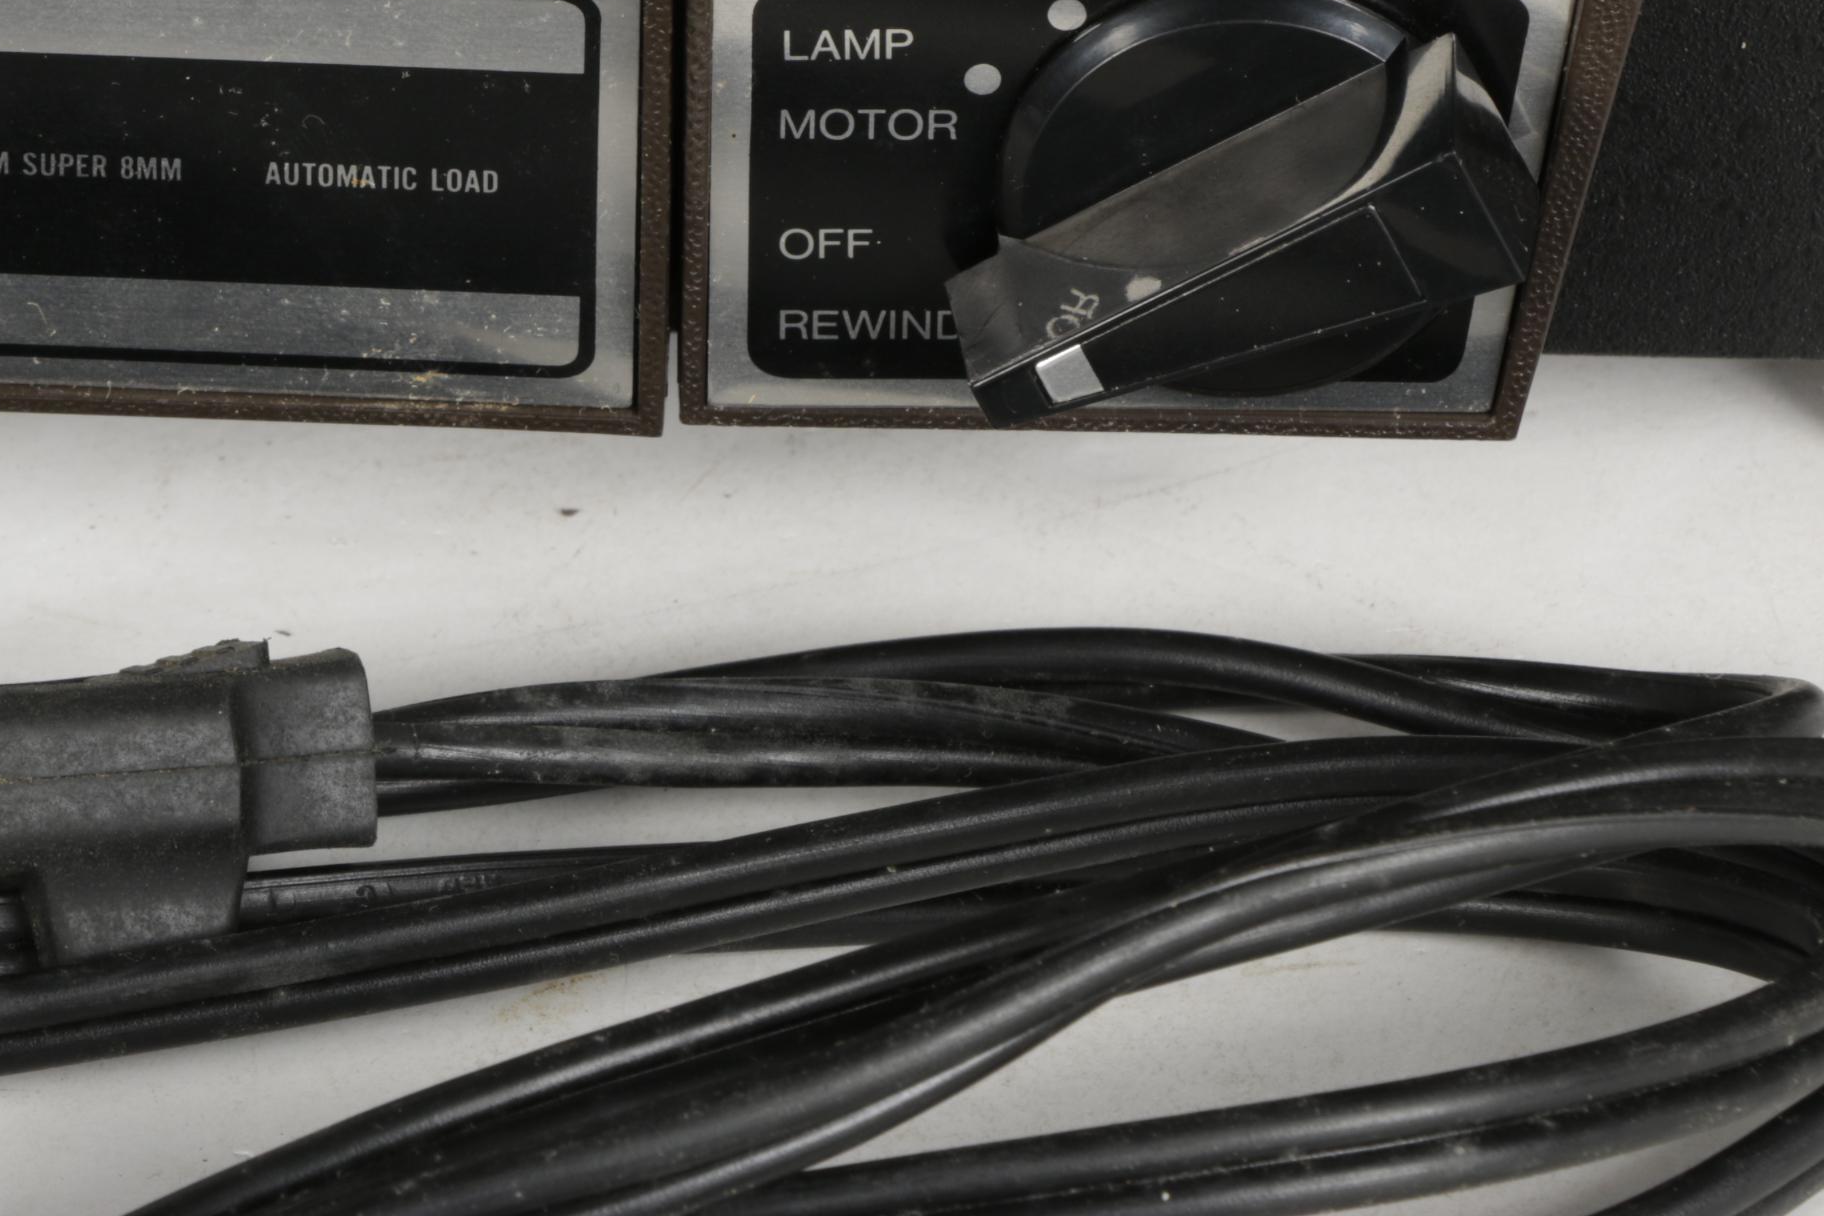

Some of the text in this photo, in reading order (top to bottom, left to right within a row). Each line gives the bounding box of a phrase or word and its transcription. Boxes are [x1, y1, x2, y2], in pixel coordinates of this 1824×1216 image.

[783, 28, 914, 61] LAMP
[779, 108, 958, 142] MOTOR
[22, 152, 108, 178] SUPER
[120, 155, 182, 181] 8MM
[265, 161, 499, 194] AUTOMATIC LOAD
[779, 228, 873, 260] OFF
